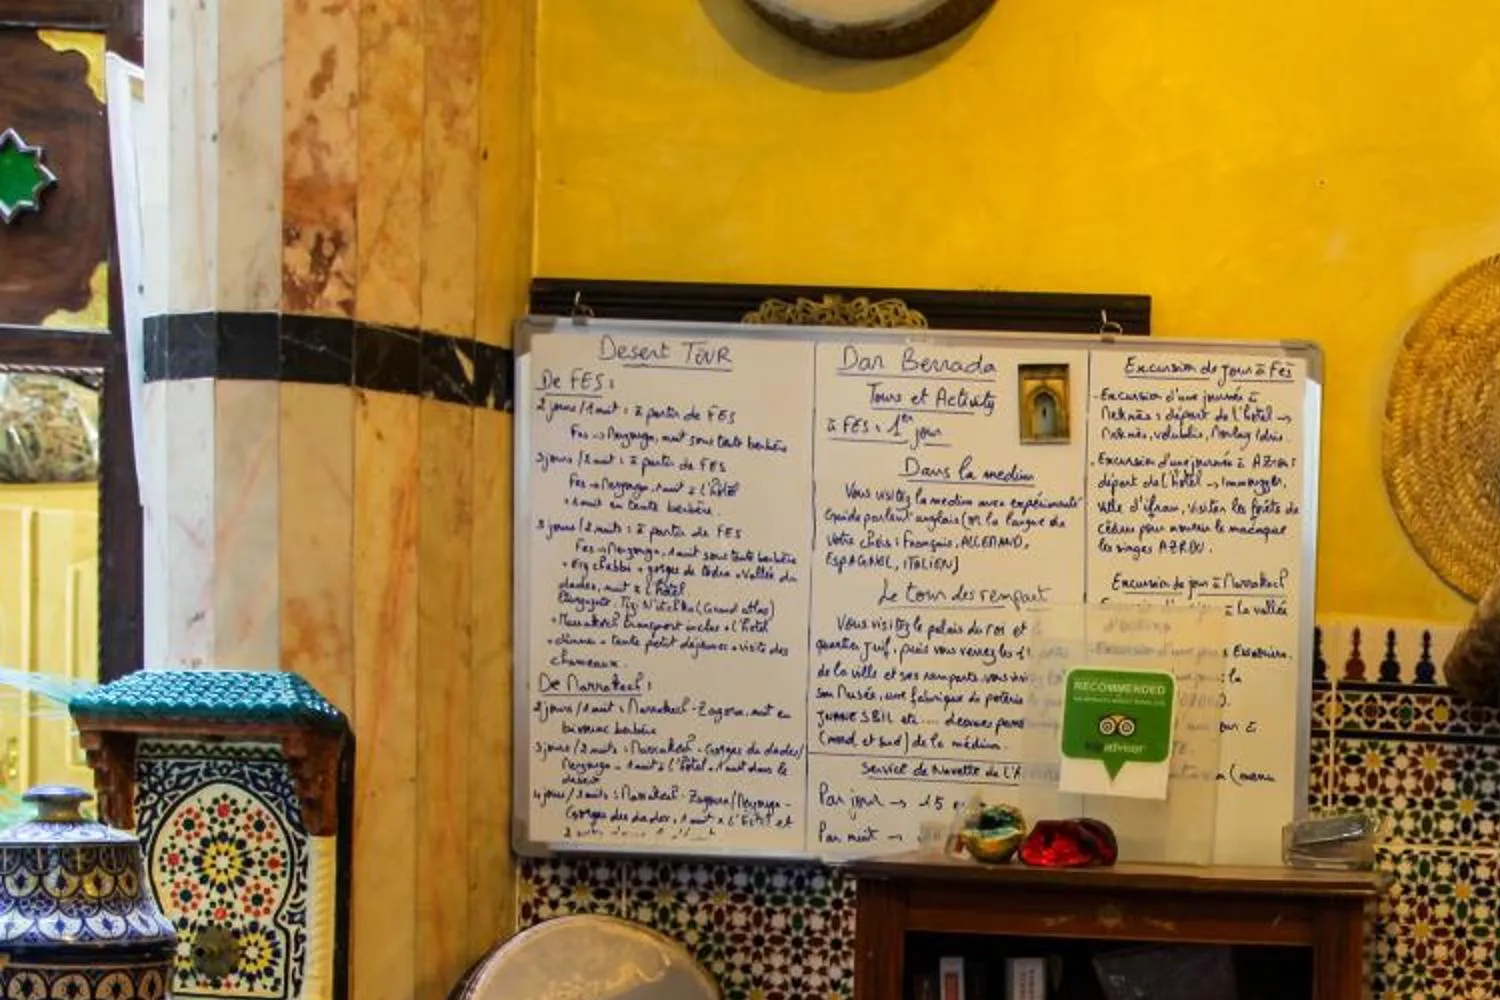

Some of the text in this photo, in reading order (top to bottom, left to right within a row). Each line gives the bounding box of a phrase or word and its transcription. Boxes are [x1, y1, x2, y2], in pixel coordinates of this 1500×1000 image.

[599, 334, 670, 361] Desert
[536, 369, 561, 392] De
[911, 388, 929, 405] et
[899, 457, 951, 480] Dans
[958, 456, 976, 481] la
[951, 585, 974, 602] des
[1013, 622, 1027, 637] et
[539, 672, 560, 692] De
[883, 668, 897, 680] et
[1073, 680, 1166, 696] RECOMMENDED
